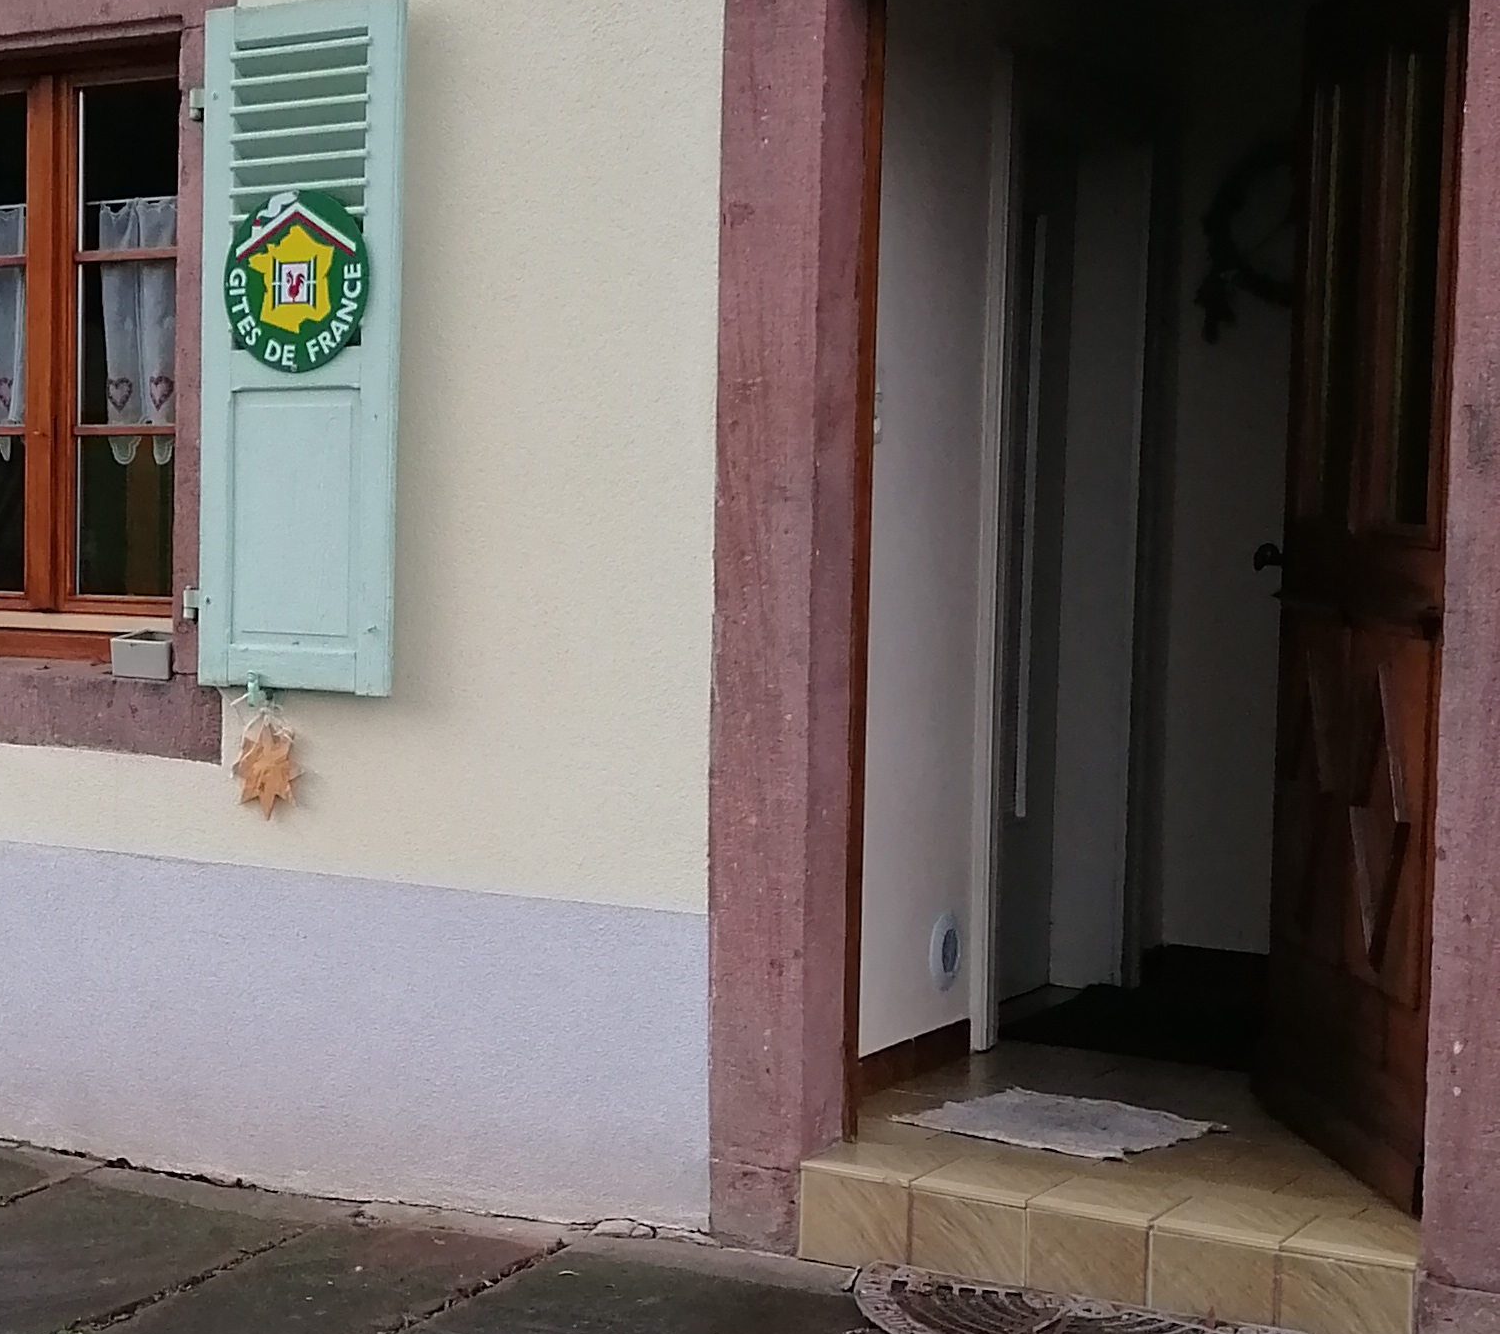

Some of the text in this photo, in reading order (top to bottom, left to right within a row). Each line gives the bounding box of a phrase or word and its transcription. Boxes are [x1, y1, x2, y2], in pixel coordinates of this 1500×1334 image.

[229, 261, 362, 367] GITES DE FRANCE
